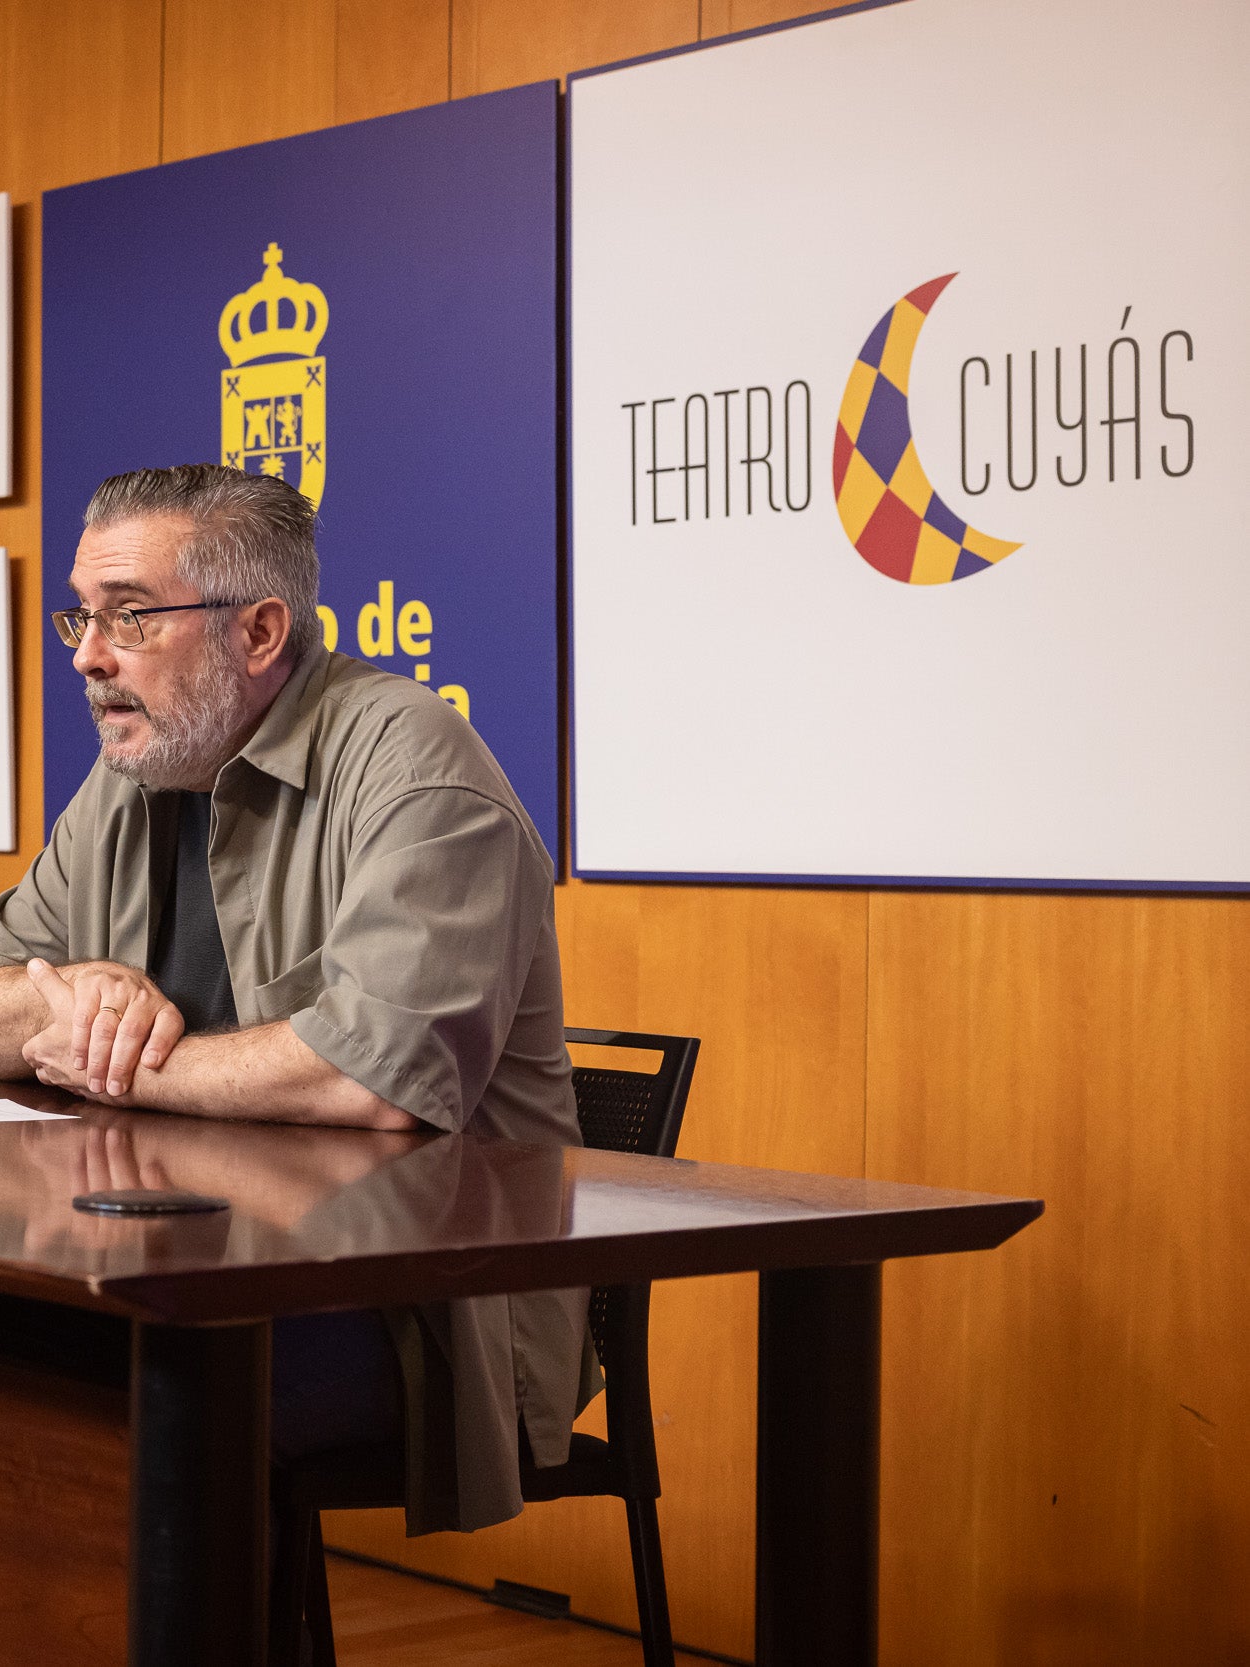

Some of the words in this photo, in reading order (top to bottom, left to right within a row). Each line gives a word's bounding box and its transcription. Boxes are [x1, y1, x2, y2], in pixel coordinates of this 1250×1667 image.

[621, 379, 812, 526] TEATRO
[960, 305, 1194, 496] CUYÁS
[357, 580, 433, 658] de
